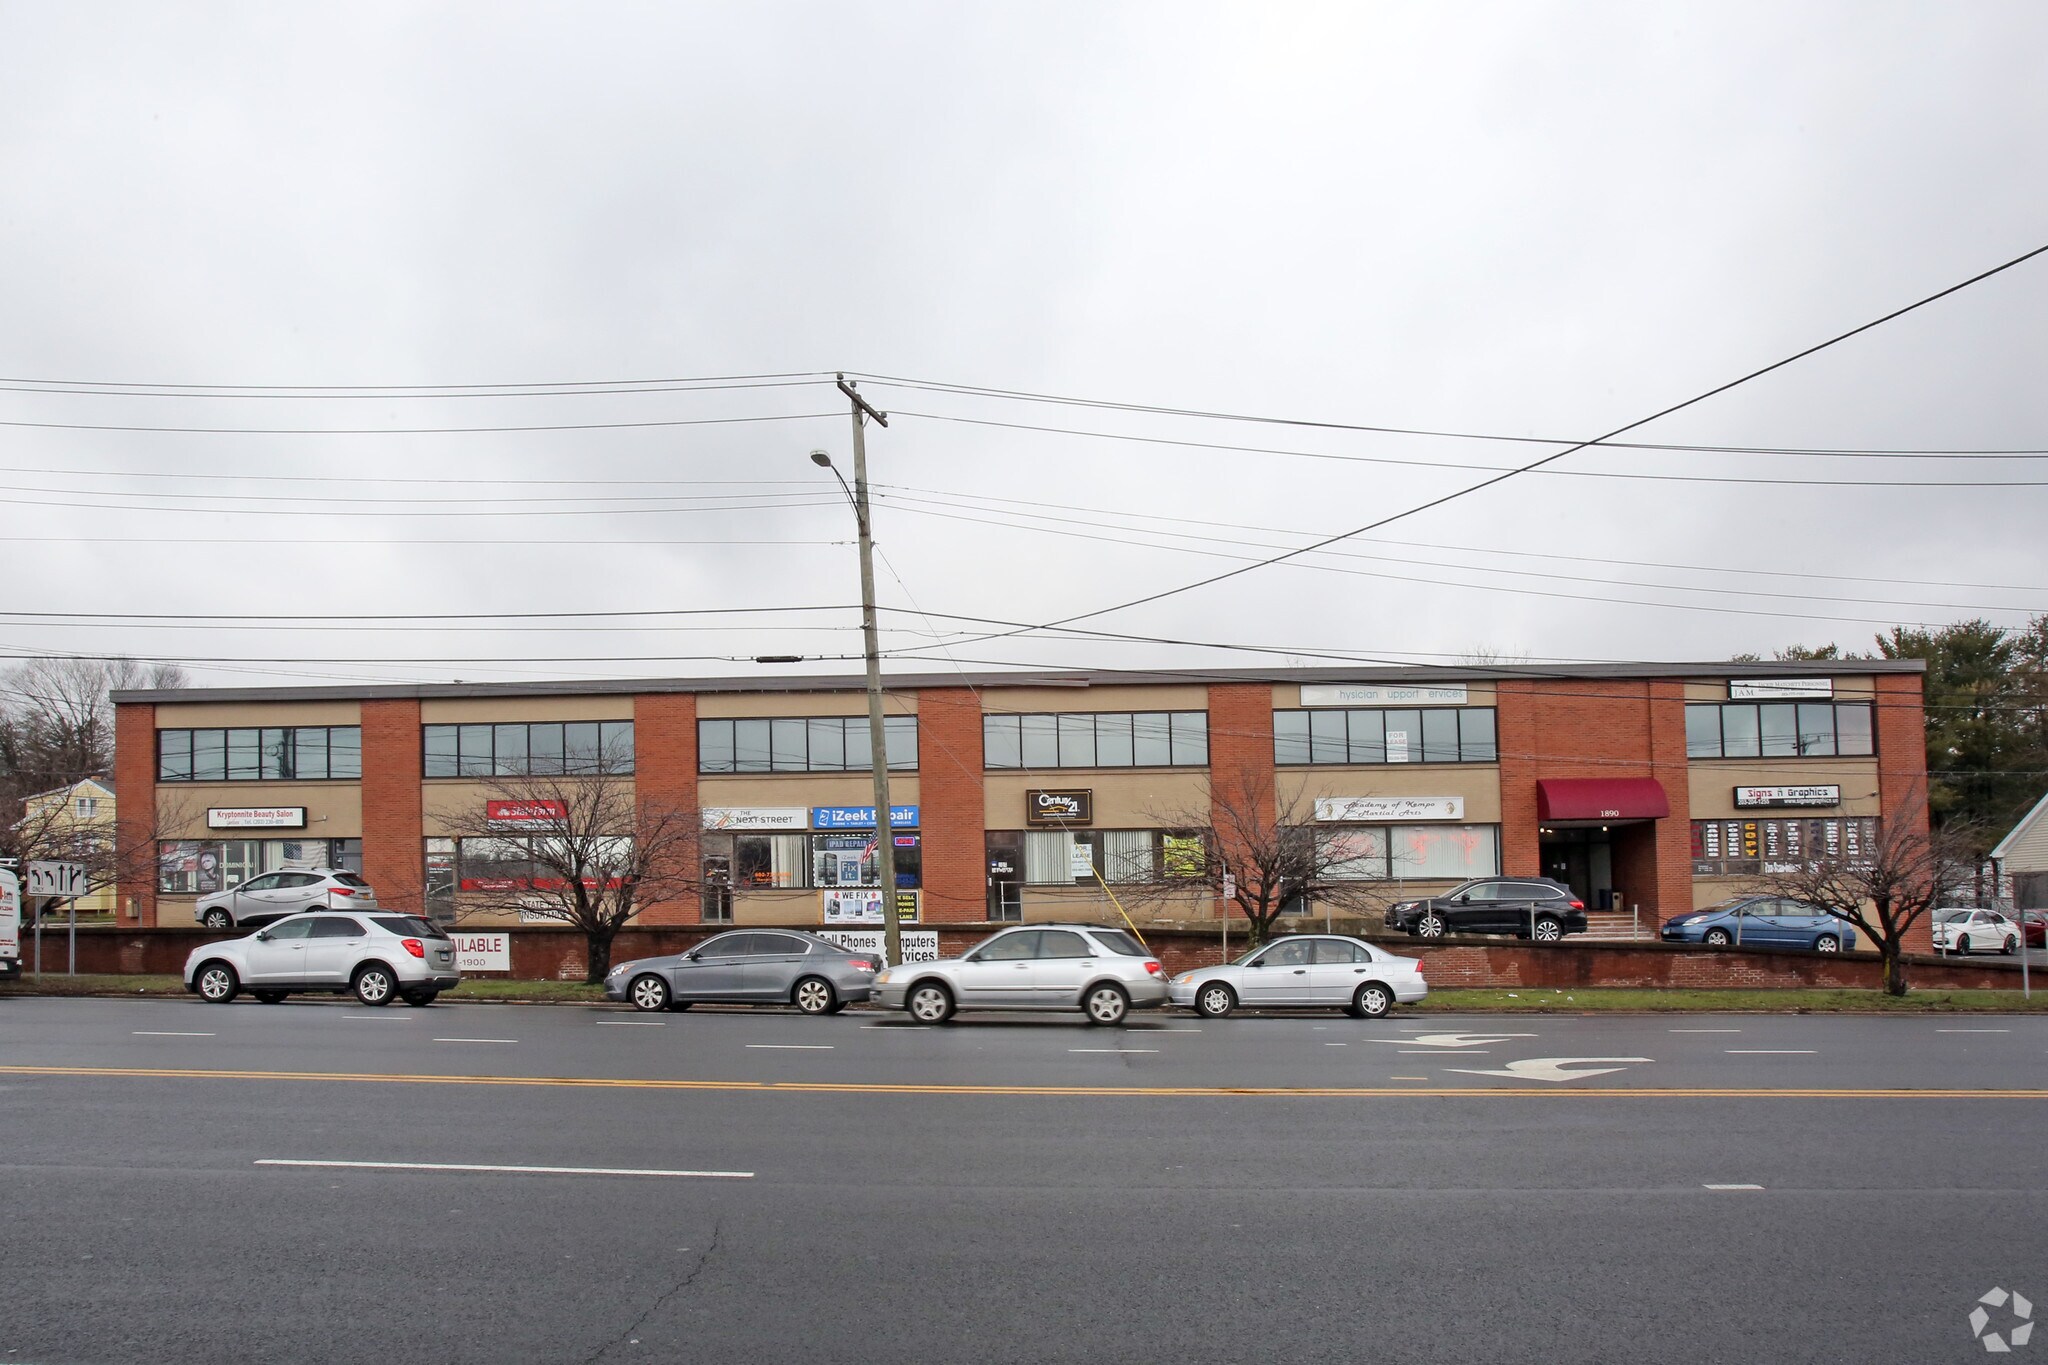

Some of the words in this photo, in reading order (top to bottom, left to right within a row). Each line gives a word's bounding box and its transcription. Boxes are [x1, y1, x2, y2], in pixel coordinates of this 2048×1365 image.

[1339, 689, 1379, 701] hysician
[1387, 689, 1419, 701] upport
[1428, 688, 1464, 699] ervices
[1734, 689, 1755, 697] JAM
[1747, 788, 1773, 800] Signs
[1787, 787, 1829, 798] Graphics
[1068, 800, 1079, 812] 21
[253, 809, 276, 820] Beauty
[276, 809, 294, 818] Salon
[832, 809, 869, 821] iZeek
[871, 808, 914, 824] Rpair
[1600, 809, 1620, 818] 1890
[1744, 823, 1757, 857] COPY
[842, 862, 857, 872] Fix
[842, 891, 854, 900] WE
[856, 891, 869, 900] FIX
[840, 934, 877, 948] Phones
